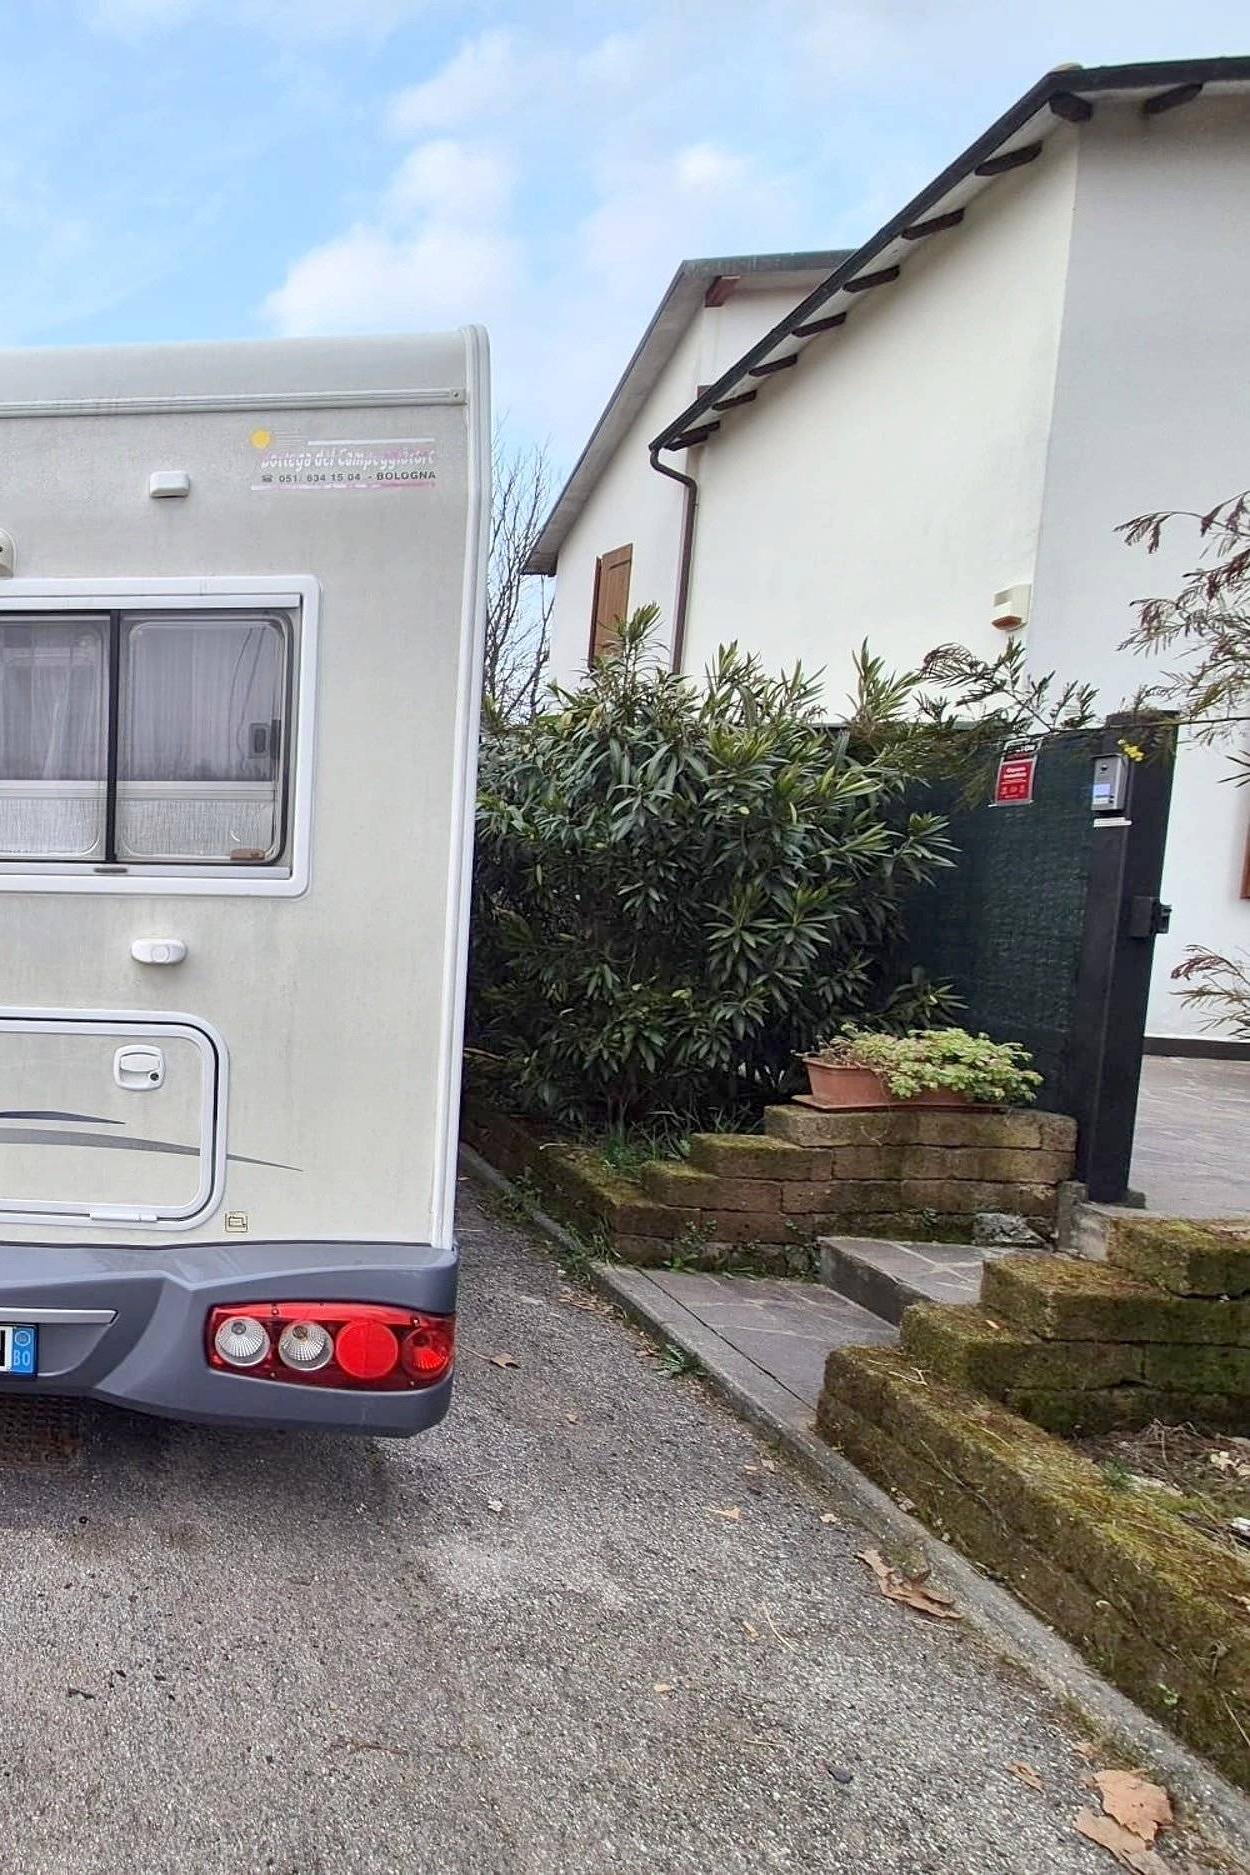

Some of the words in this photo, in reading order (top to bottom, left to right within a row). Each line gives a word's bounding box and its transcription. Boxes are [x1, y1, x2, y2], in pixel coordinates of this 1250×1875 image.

[306, 474, 326, 483] 634
[331, 473, 344, 482] 15
[347, 473, 361, 482] 04
[376, 470, 436, 481] BOLOGNA
[13, 1349, 31, 1367] BO
